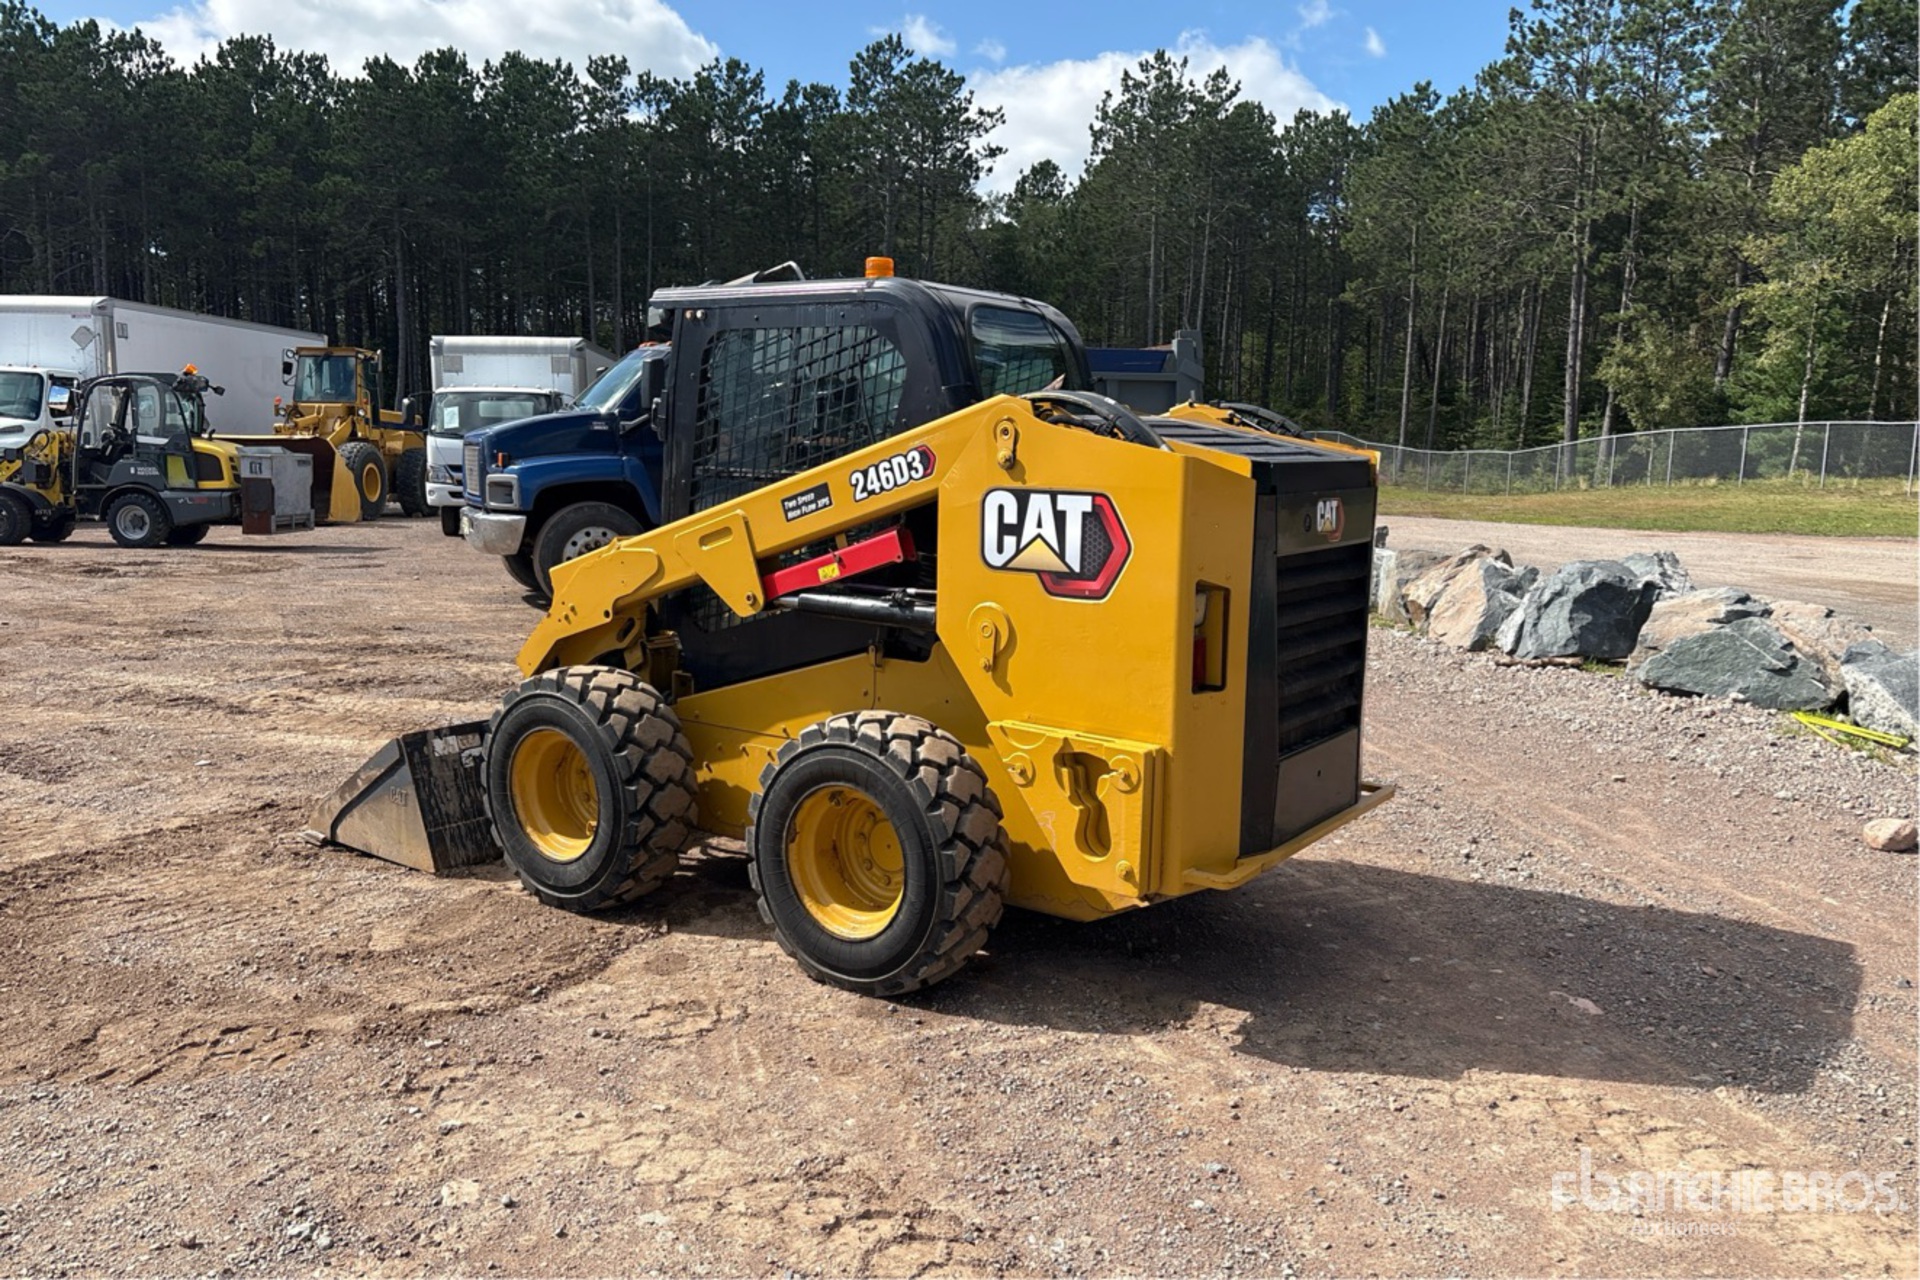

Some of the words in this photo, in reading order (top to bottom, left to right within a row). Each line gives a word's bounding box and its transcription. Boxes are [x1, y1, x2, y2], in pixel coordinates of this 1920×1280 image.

[851, 450, 924, 501] 246D3
[984, 490, 1092, 573] CAT
[1317, 500, 1338, 532] CAT
[390, 786, 407, 806] CAT
